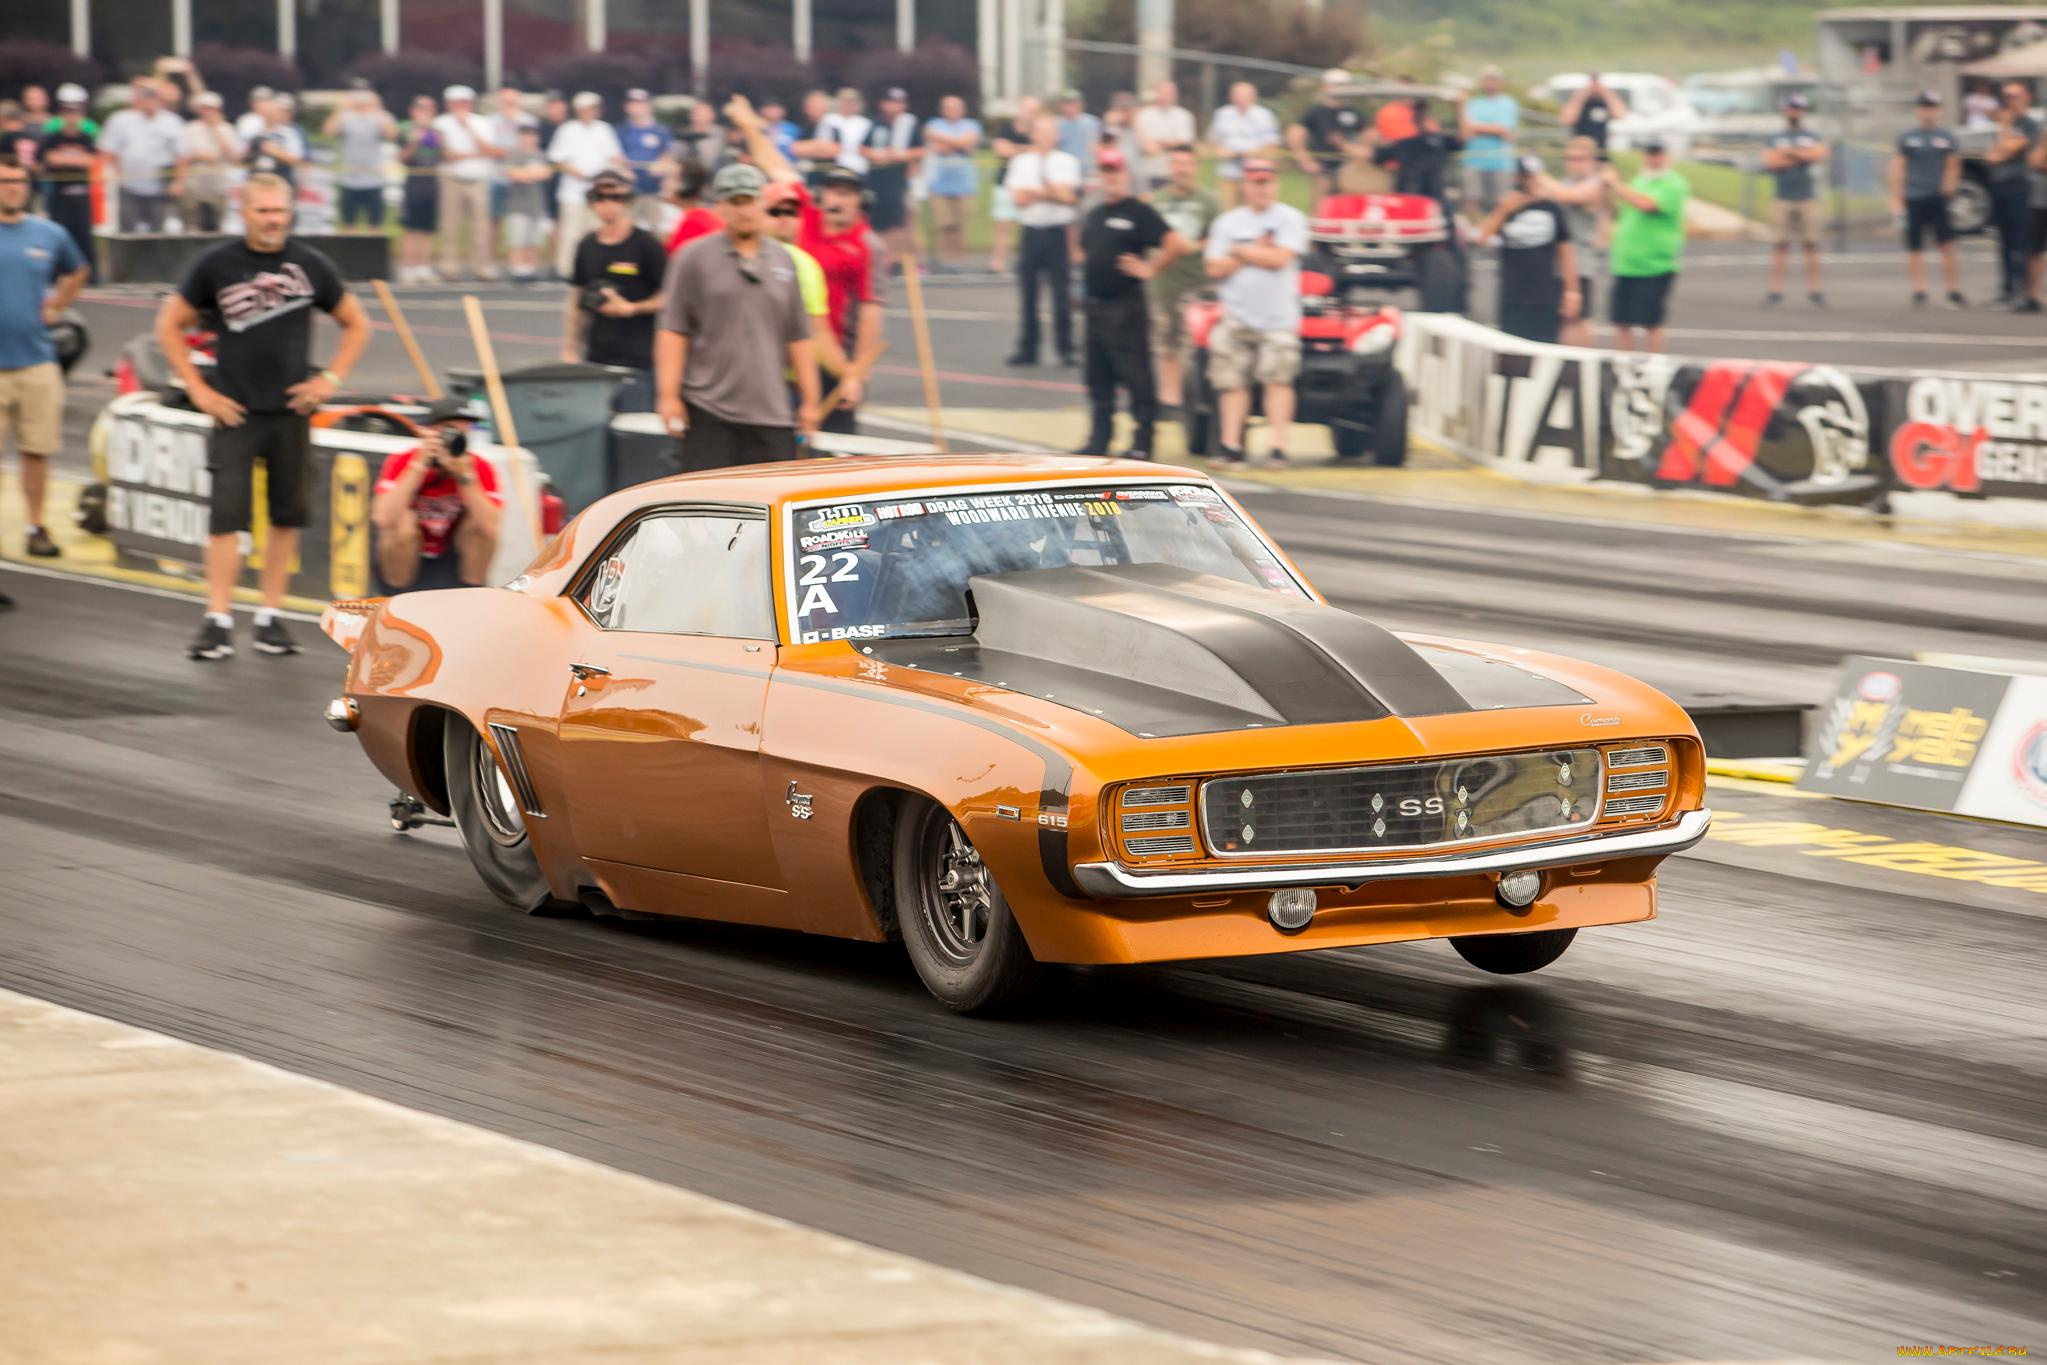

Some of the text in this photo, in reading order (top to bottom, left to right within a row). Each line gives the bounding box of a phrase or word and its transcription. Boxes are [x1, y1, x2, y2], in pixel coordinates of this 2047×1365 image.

[926, 493, 1053, 513] DRAG WEEK 2018
[945, 505, 1030, 526] WOODWARD
[1031, 503, 1085, 519] AVENUE
[801, 529, 868, 547] ROADKILL
[799, 552, 860, 586] 22
[798, 584, 838, 617] A
[831, 624, 885, 640] BASF
[792, 804, 813, 819] SS
[1400, 797, 1444, 816] SS
[1038, 814, 1068, 828] 615
